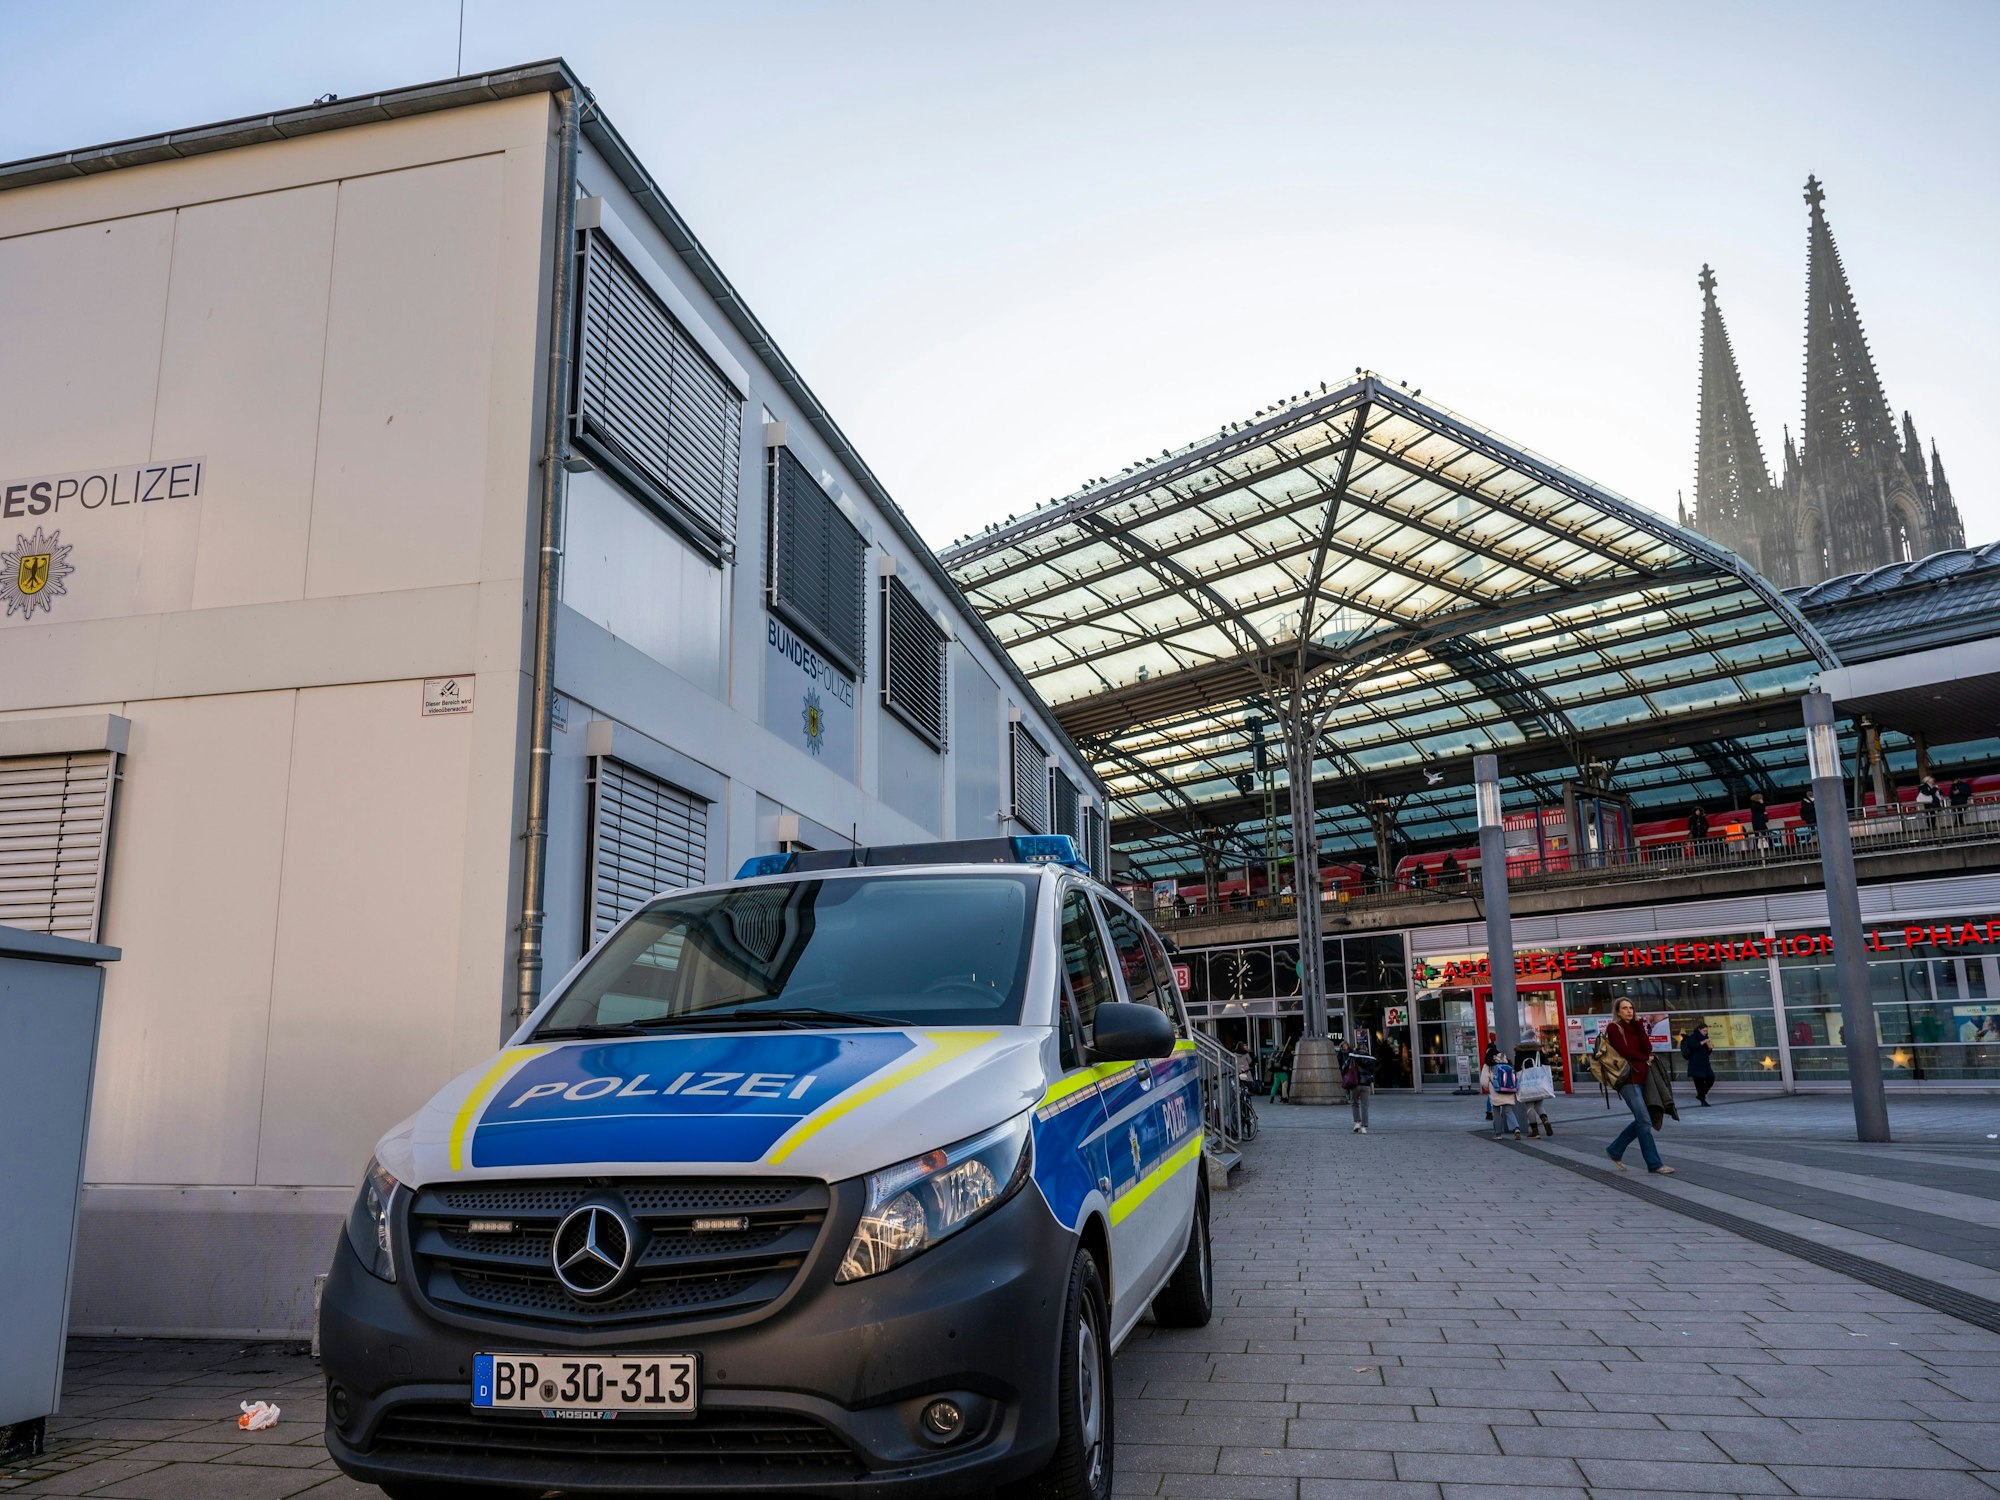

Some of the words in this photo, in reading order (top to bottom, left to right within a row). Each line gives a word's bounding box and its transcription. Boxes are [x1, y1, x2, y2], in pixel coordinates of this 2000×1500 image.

[0, 463, 201, 518] ESPOLIZEI
[768, 618, 854, 709] BUNDESPOLIZEI
[1443, 952, 1578, 979] APOHEKE
[1623, 930, 1890, 967] INTERNATIONL
[508, 1072, 818, 1109] POLIZEI
[1162, 1095, 1188, 1145] POLIZEI
[480, 1385, 488, 1397] D
[496, 1362, 539, 1401] BP
[561, 1363, 690, 1403] 30-313
[556, 1411, 604, 1419] MOSOLF
